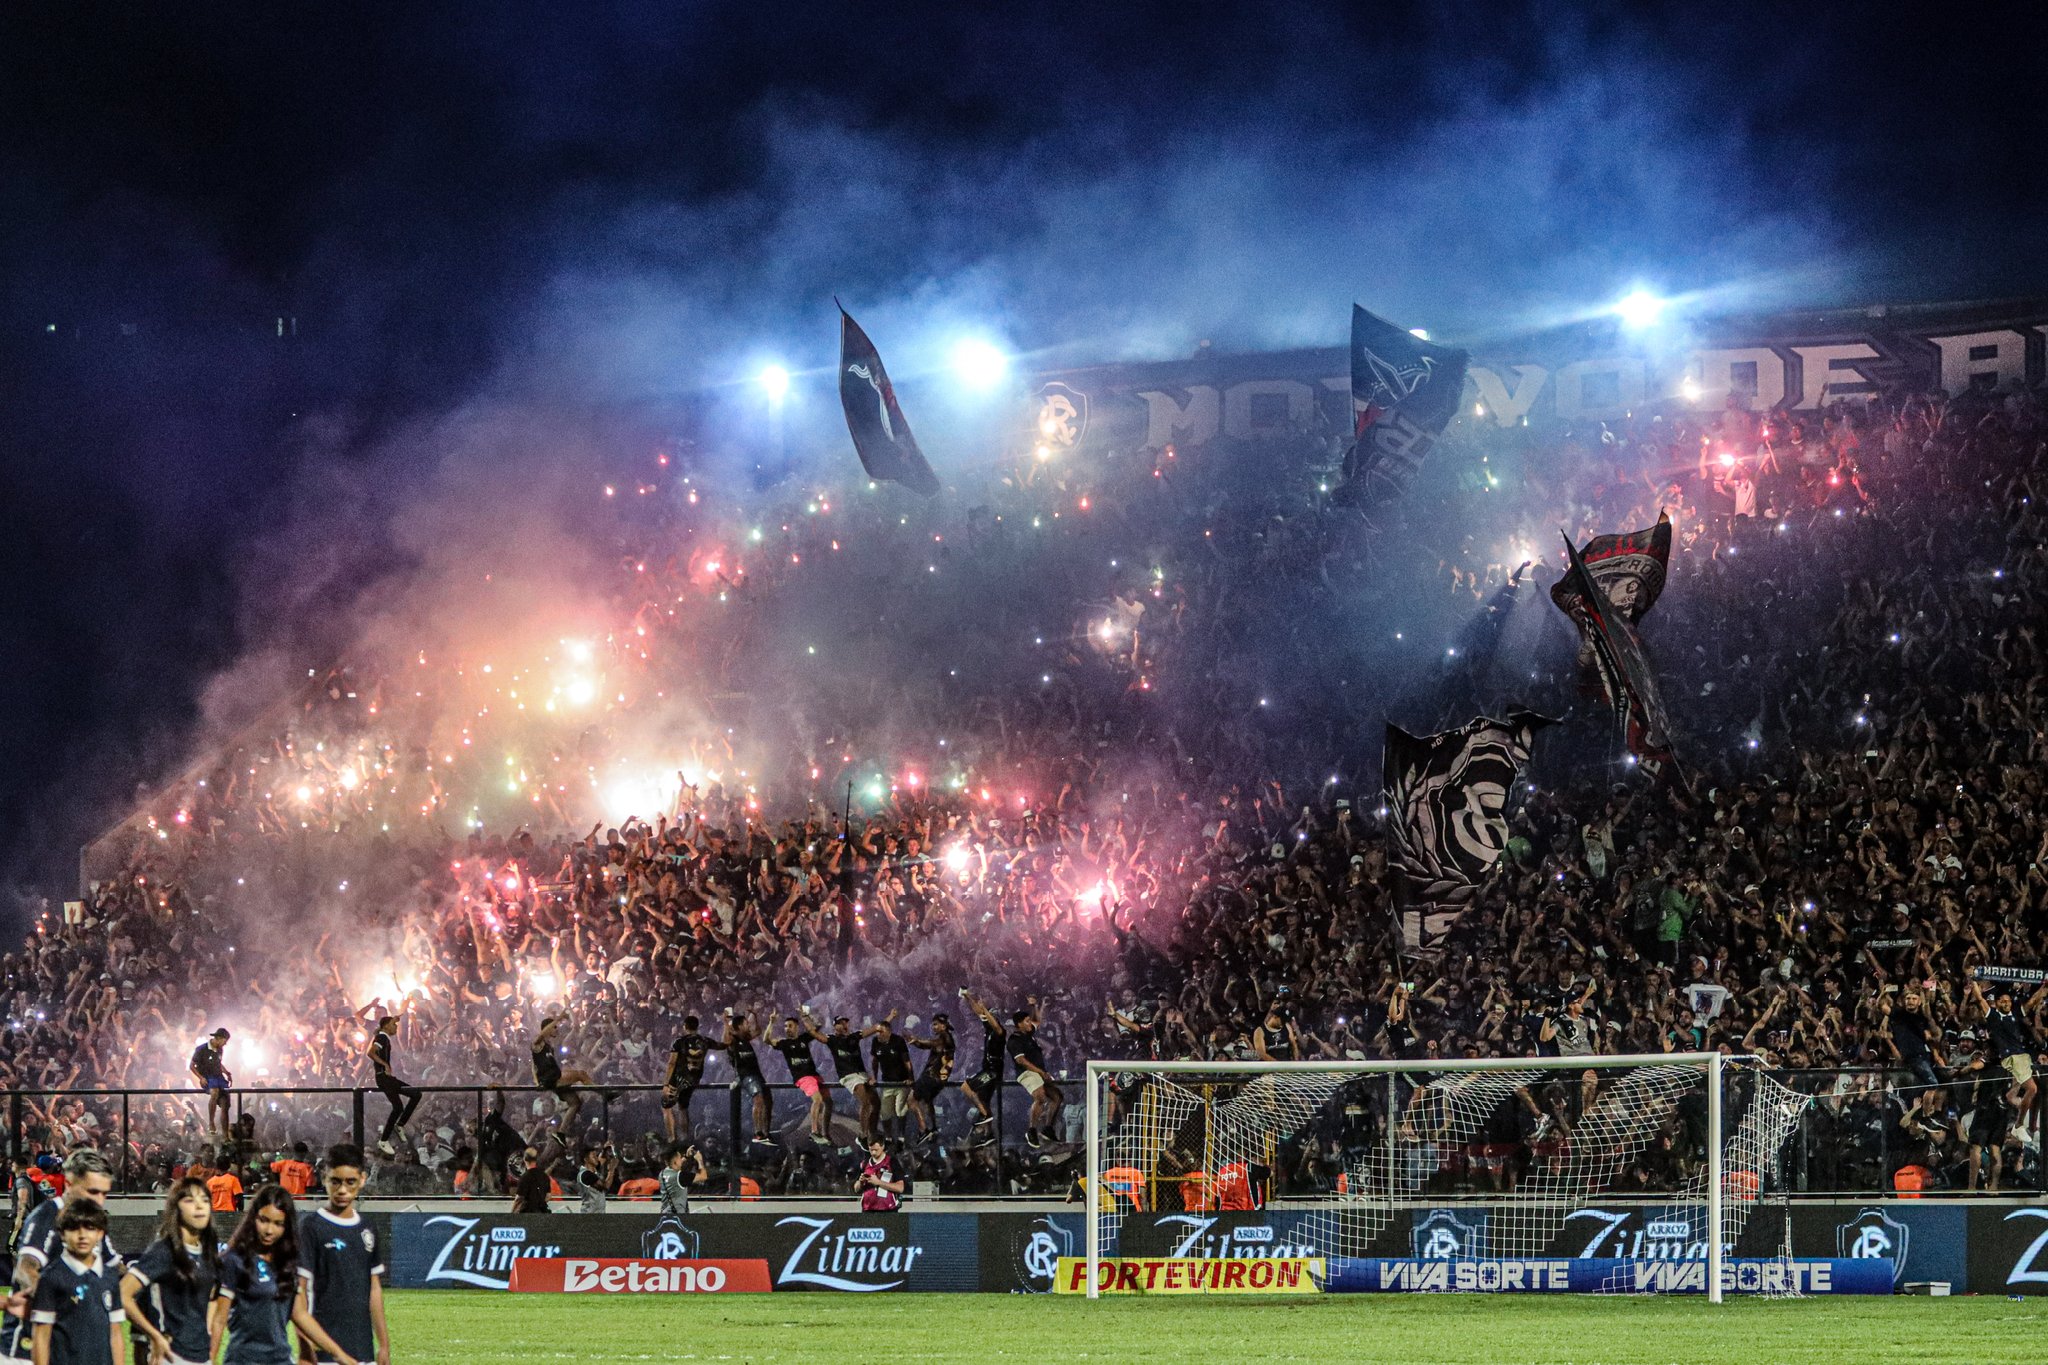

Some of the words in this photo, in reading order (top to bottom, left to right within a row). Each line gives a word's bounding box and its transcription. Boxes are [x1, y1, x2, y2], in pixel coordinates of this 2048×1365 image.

[1692, 343, 1881, 412] DE
[493, 1230, 525, 1240] ARROZ
[850, 1230, 884, 1240] ARROZ
[1235, 1229, 1271, 1239] ARROZ
[1650, 1226, 1687, 1236] ARROZ
[774, 1216, 923, 1292] Zilmar
[564, 1260, 726, 1292] Betano
[1070, 1261, 1302, 1291] FORTEVIRON
[1380, 1262, 1449, 1289] VIVA
[1456, 1261, 1569, 1289] SORTE
[1635, 1262, 1705, 1290] VIVA
[1720, 1262, 1832, 1291] SORTE
